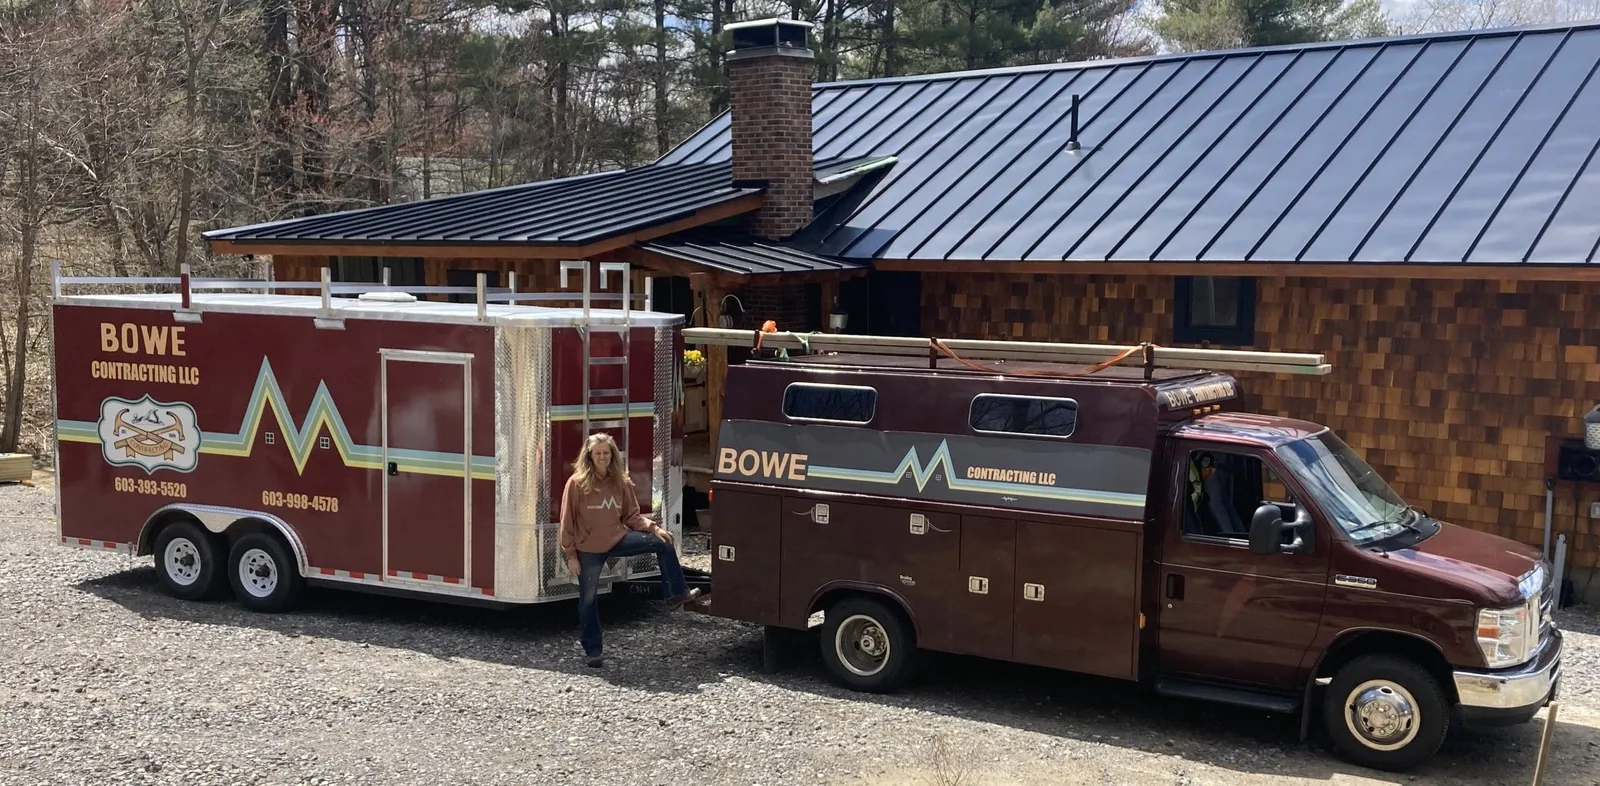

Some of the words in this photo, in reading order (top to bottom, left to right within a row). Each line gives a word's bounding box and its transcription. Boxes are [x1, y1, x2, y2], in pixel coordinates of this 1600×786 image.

[100, 322, 187, 356] BOWE
[91, 360, 177, 384] CONTRACTING
[178, 366, 200, 386] LLC
[1165, 388, 1193, 408] BOWE
[718, 447, 807, 481] BOWE
[115, 477, 187, 498] 603-393-5520
[966, 466, 1037, 484] CONTRACTING
[1038, 471, 1057, 486] LLC
[262, 490, 339, 513] 603-998-4578
